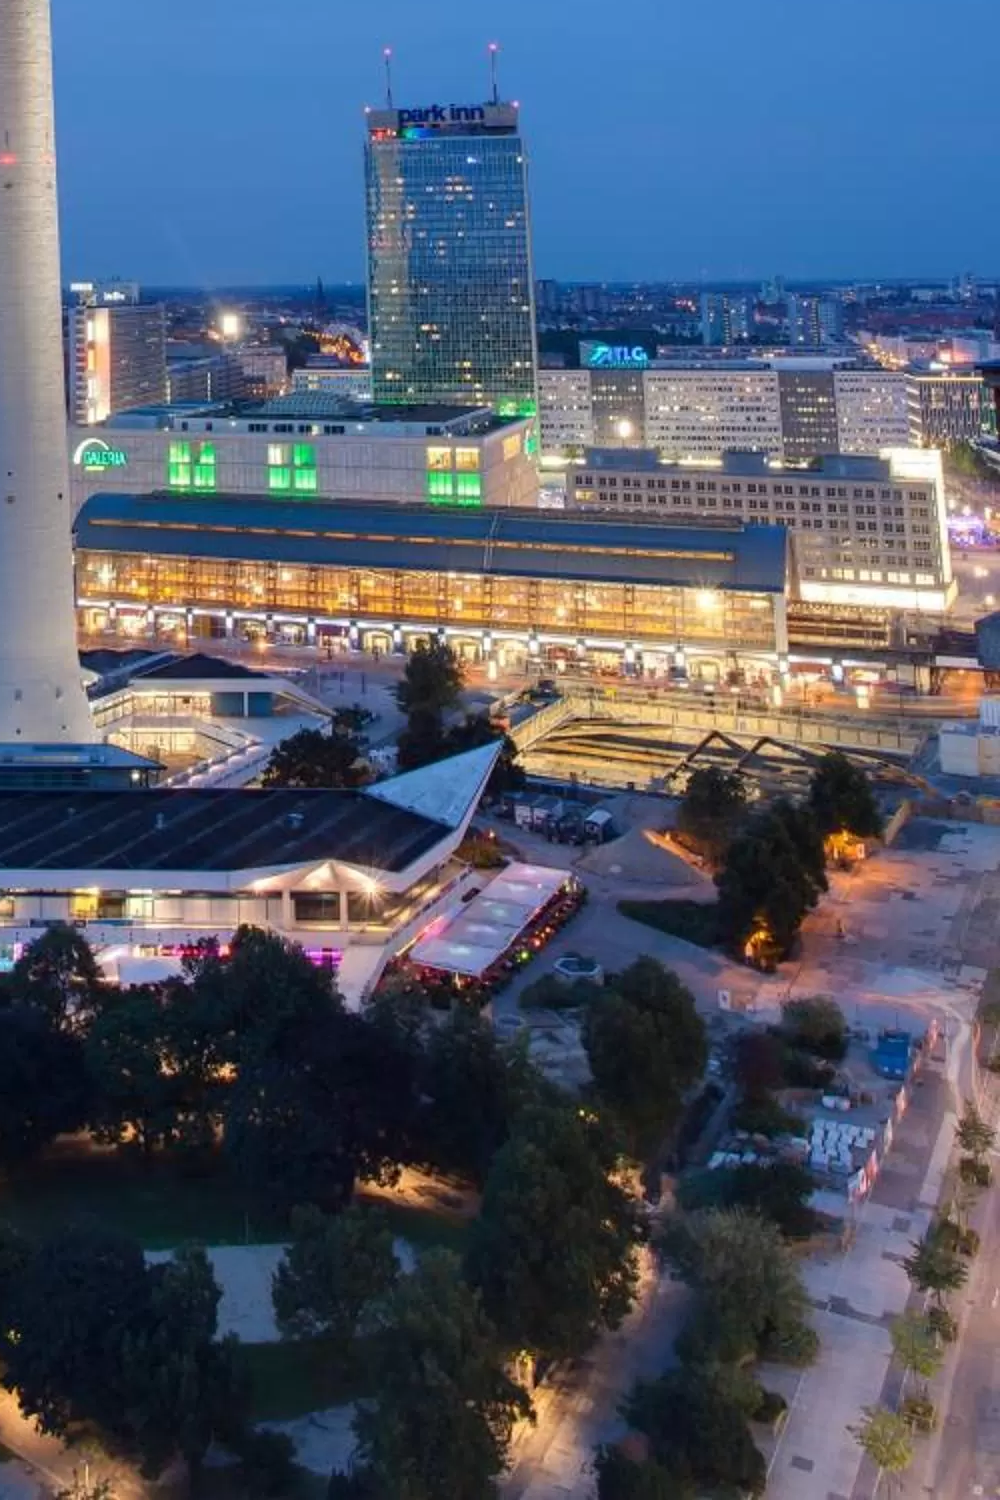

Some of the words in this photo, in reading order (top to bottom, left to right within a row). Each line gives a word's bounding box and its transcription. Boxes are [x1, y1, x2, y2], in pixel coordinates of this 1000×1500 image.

[398, 105, 446, 126] park
[449, 104, 484, 121] inn
[84, 451, 127, 465] GALERIA
